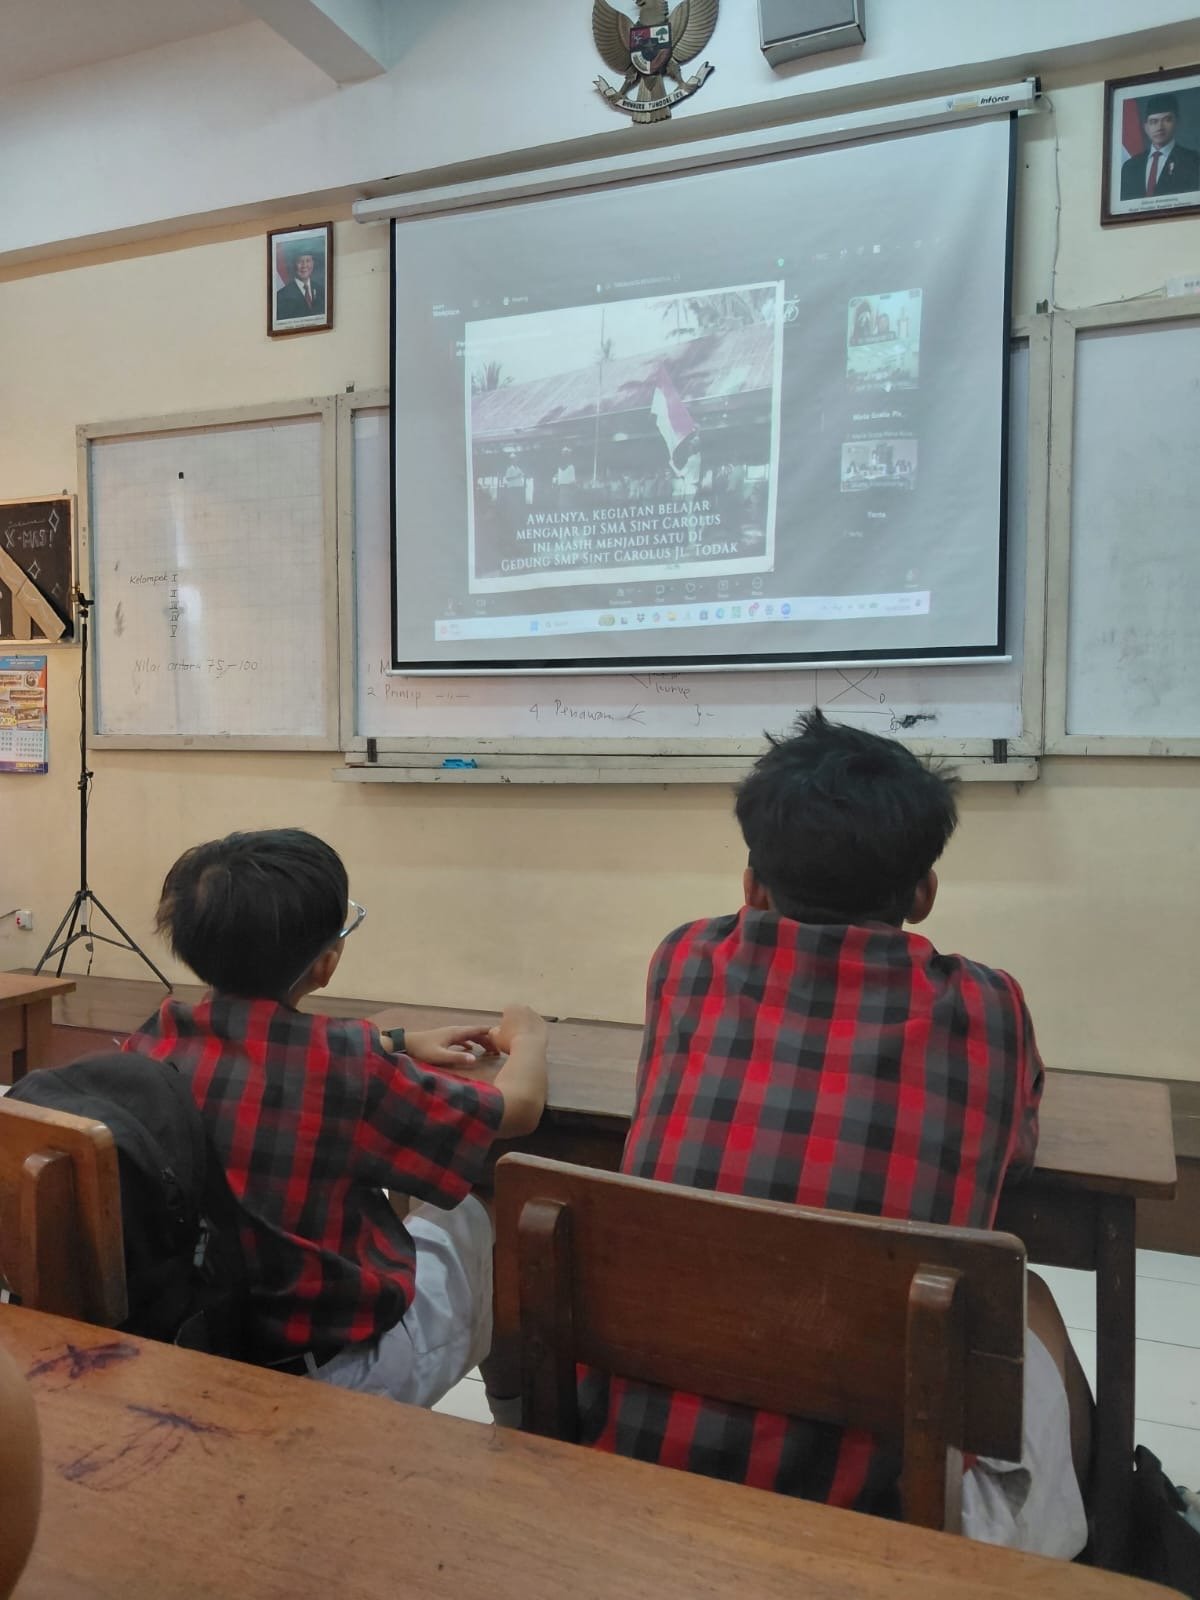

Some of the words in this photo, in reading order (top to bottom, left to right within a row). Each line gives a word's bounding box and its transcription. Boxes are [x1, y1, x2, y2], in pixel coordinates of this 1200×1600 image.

[980, 95, 1010, 105] Inforce
[592, 504, 654, 520] KEGIATAN
[658, 499, 711, 515] BELAJAR
[516, 522, 579, 541] MENGAJAR
[583, 525, 597, 536] DI
[600, 522, 626, 535] SMA
[630, 518, 660, 532] SINT
[662, 513, 722, 530] CAROLUS
[533, 542, 551, 554] INI
[554, 538, 593, 553] MASIH
[596, 534, 650, 550] MENJADI
[653, 531, 685, 546] SATU
[688, 531, 703, 544] DI
[501, 556, 551, 572] GEDUNG
[554, 552, 579, 567] SMP
[583, 550, 610, 564] SINT
[614, 546, 671, 562] CAROLUS
[693, 541, 739, 557] TODAK
